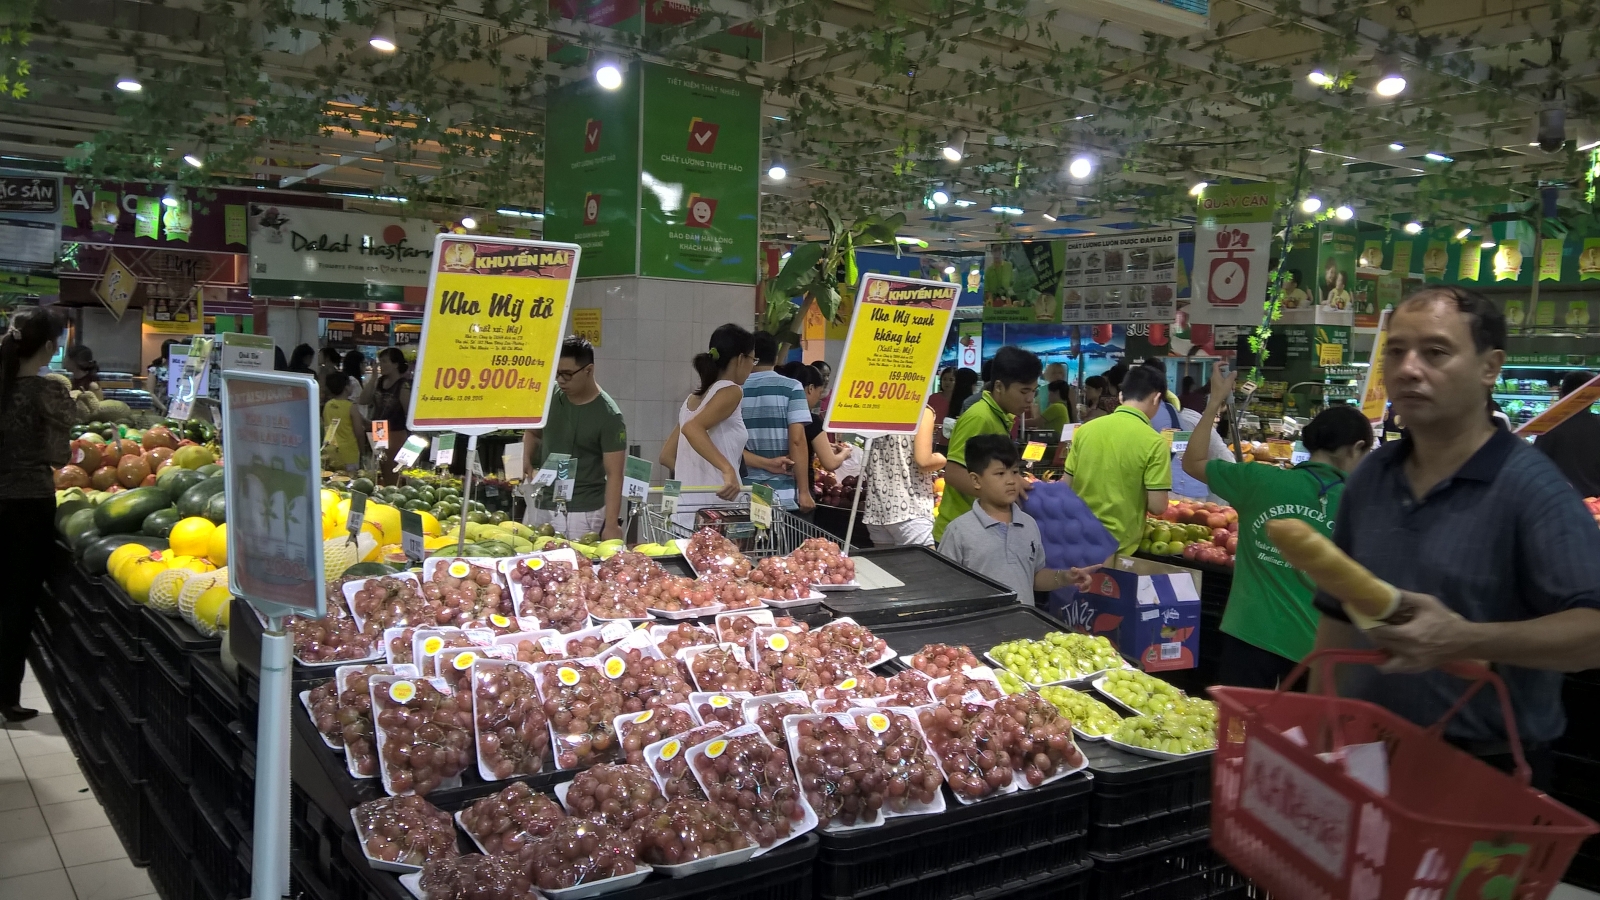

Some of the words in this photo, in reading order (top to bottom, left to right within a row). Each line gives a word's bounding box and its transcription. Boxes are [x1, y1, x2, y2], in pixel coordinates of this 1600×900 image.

[661, 154, 680, 164] CHẤT
[21, 179, 53, 201] SẢN
[291, 230, 352, 253] Dalat
[475, 250, 539, 269] KHUYẾN
[888, 287, 932, 301] KHUYẾN
[439, 291, 481, 315] Nho
[488, 293, 524, 323] Mỹ
[529, 296, 554, 320] đỏ
[870, 307, 890, 322] Nho
[892, 309, 911, 327] Mỹ
[911, 314, 935, 326] xanh
[361, 323, 373, 336] 14
[396, 333, 410, 343] 125
[873, 328, 902, 345] không
[904, 331, 921, 347] hạt
[434, 367, 541, 392] 109.900đ/kg
[849, 380, 921, 403] 129.900đ/kg
[1269, 504, 1328, 523] SERVICE
